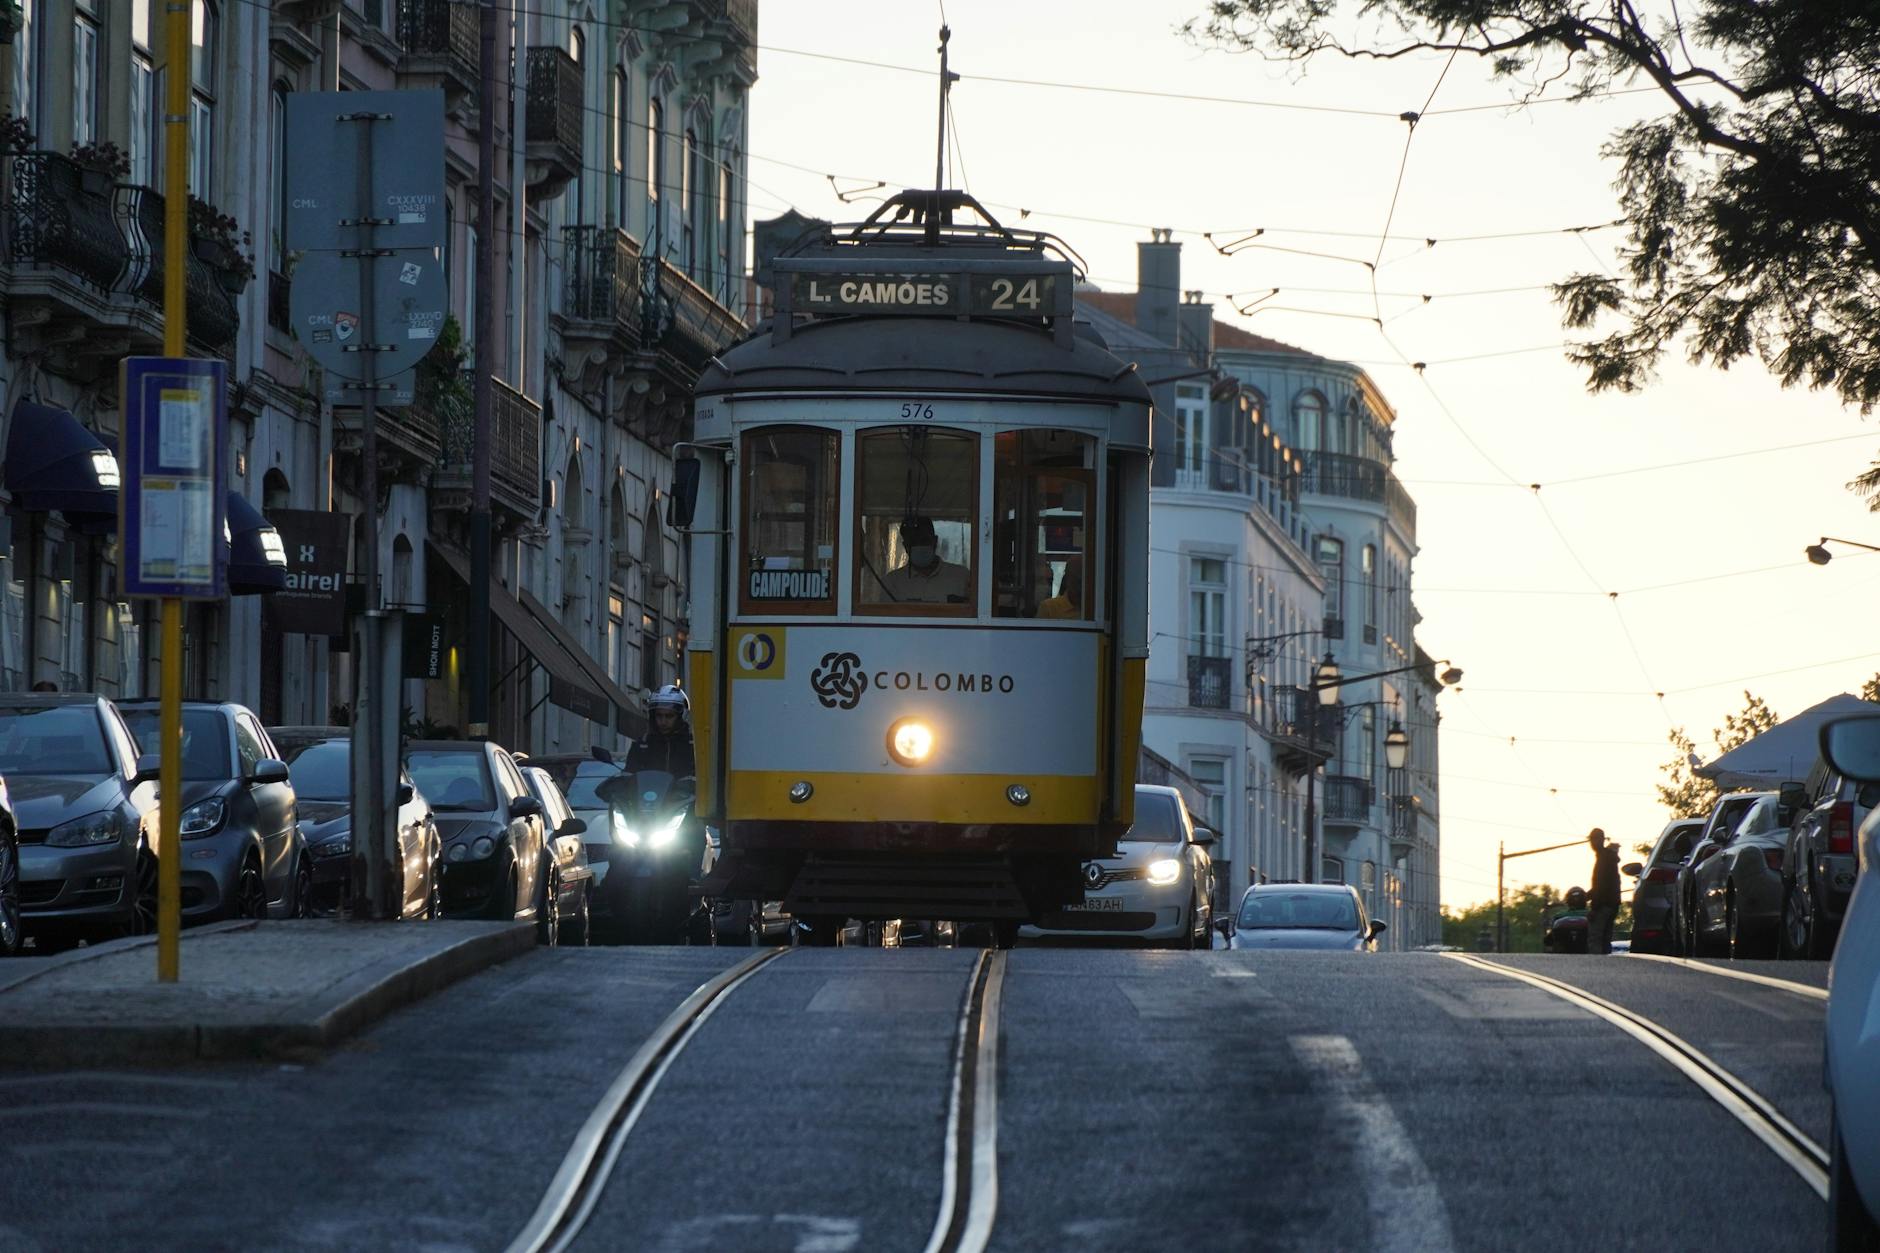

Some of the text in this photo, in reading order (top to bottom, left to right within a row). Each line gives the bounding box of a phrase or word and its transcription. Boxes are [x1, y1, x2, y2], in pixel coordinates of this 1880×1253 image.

[292, 199, 318, 209] CML
[809, 281, 831, 302] L.
[991, 279, 1040, 310] 24
[308, 315, 334, 326] CML
[901, 403, 934, 420] 576
[750, 571, 829, 599] CAMPOLIDE
[429, 625, 441, 677] SHON MOTT
[874, 671, 1014, 693] COLOMBO
[1088, 899, 1101, 910] 63
[1104, 899, 1120, 910] AH
